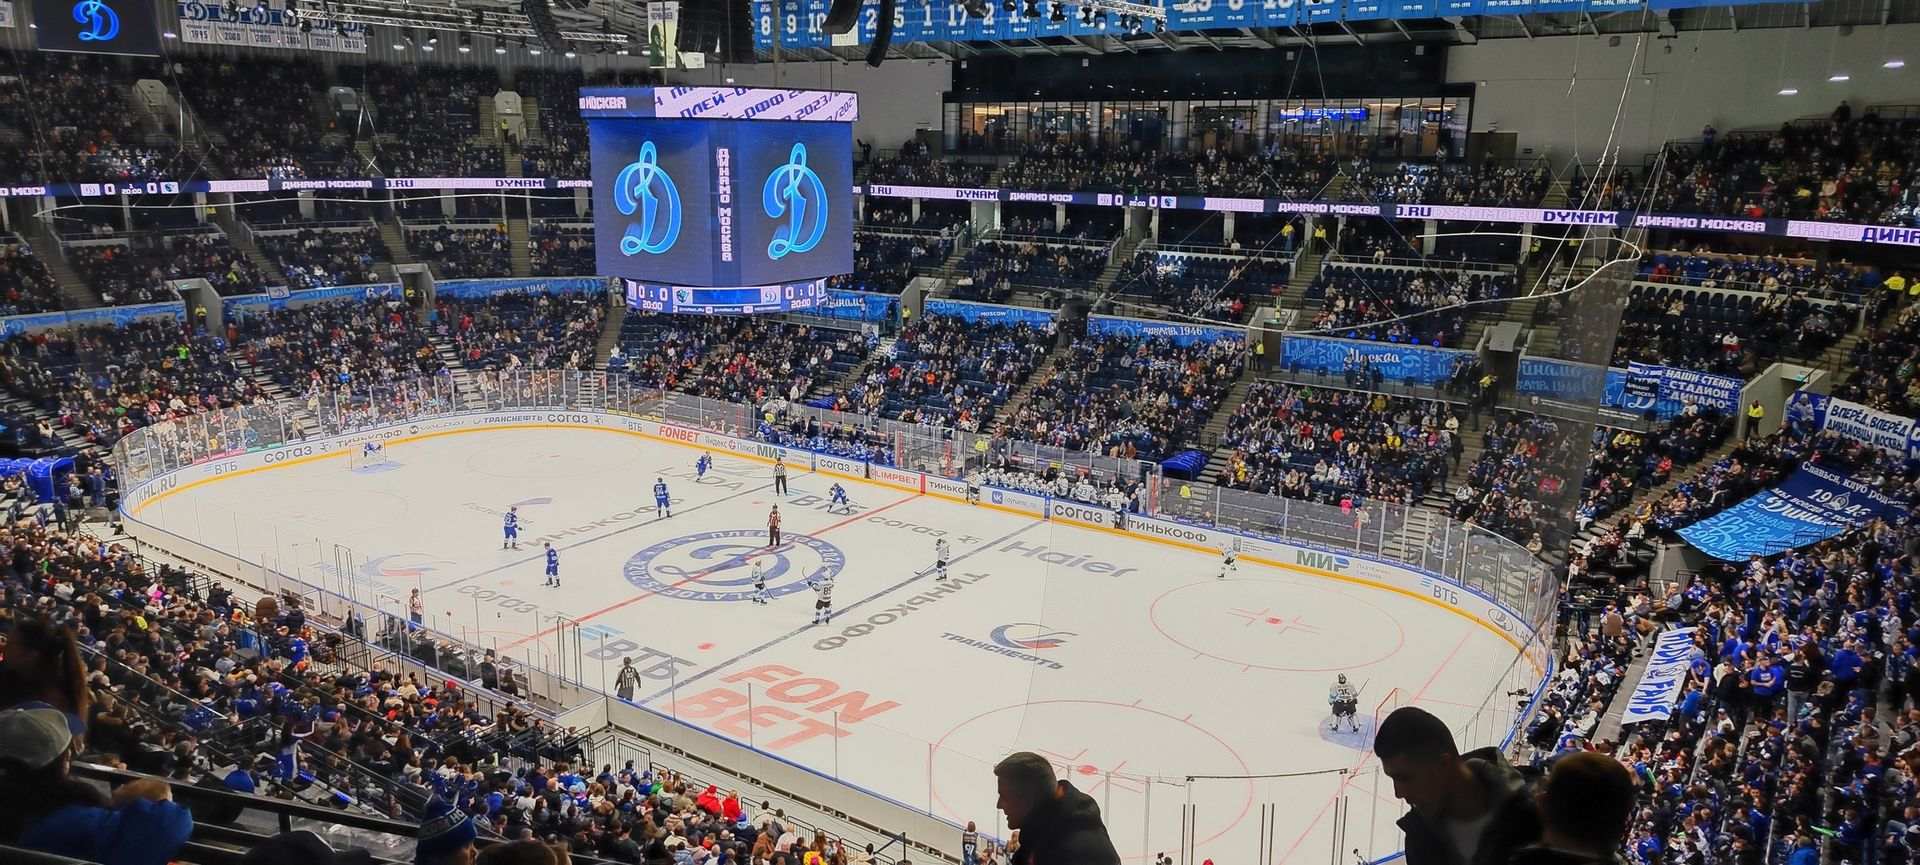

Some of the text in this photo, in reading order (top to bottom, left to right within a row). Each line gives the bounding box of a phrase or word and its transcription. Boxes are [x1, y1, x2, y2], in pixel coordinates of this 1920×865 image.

[787, 14, 796, 34] 9
[893, 6, 904, 28] 5
[924, 4, 932, 26] 1
[948, 4, 968, 26] 17
[761, 15, 770, 36] 8
[586, 96, 626, 109] МОСКВА
[282, 180, 372, 190] ДИНАМО МОСКВА
[718, 148, 733, 262] ДИНАМО МОСКВА
[1009, 193, 1047, 201] ДИНАМО
[1278, 203, 1380, 215] ДИНАМО МОСКВА
[1635, 215, 1766, 232] ДИНАМО МОСКВА
[642, 300, 663, 311] 20:00
[791, 298, 811, 309] 20:00
[1179, 326, 1203, 336] 1946
[1666, 369, 1700, 382] НАШИ
[1669, 380, 1729, 399] СТАДИОН
[483, 414, 543, 425] ТРАНСНЕФТЬ
[628, 420, 643, 432] ВТБ
[659, 425, 700, 443] FONBET
[757, 444, 788, 459] МИР
[214, 461, 239, 475] ВТБ
[870, 468, 917, 485] OLIMPBET
[929, 481, 970, 494] ТИНЬКО
[1128, 519, 1207, 543] ТИНЬКОФФ
[997, 540, 1139, 578] Haier
[1296, 550, 1350, 572] МИР
[823, 586, 832, 595] 85
[1433, 584, 1458, 605] ВТБ
[813, 571, 991, 651] ТИНЬКОФФ
[583, 638, 698, 680] ВТБ
[940, 632, 1064, 670] ТРАНСНЕФТЬ
[718, 664, 903, 724] FON
[1628, 679, 1677, 716] FANS
[667, 687, 854, 751] BET
